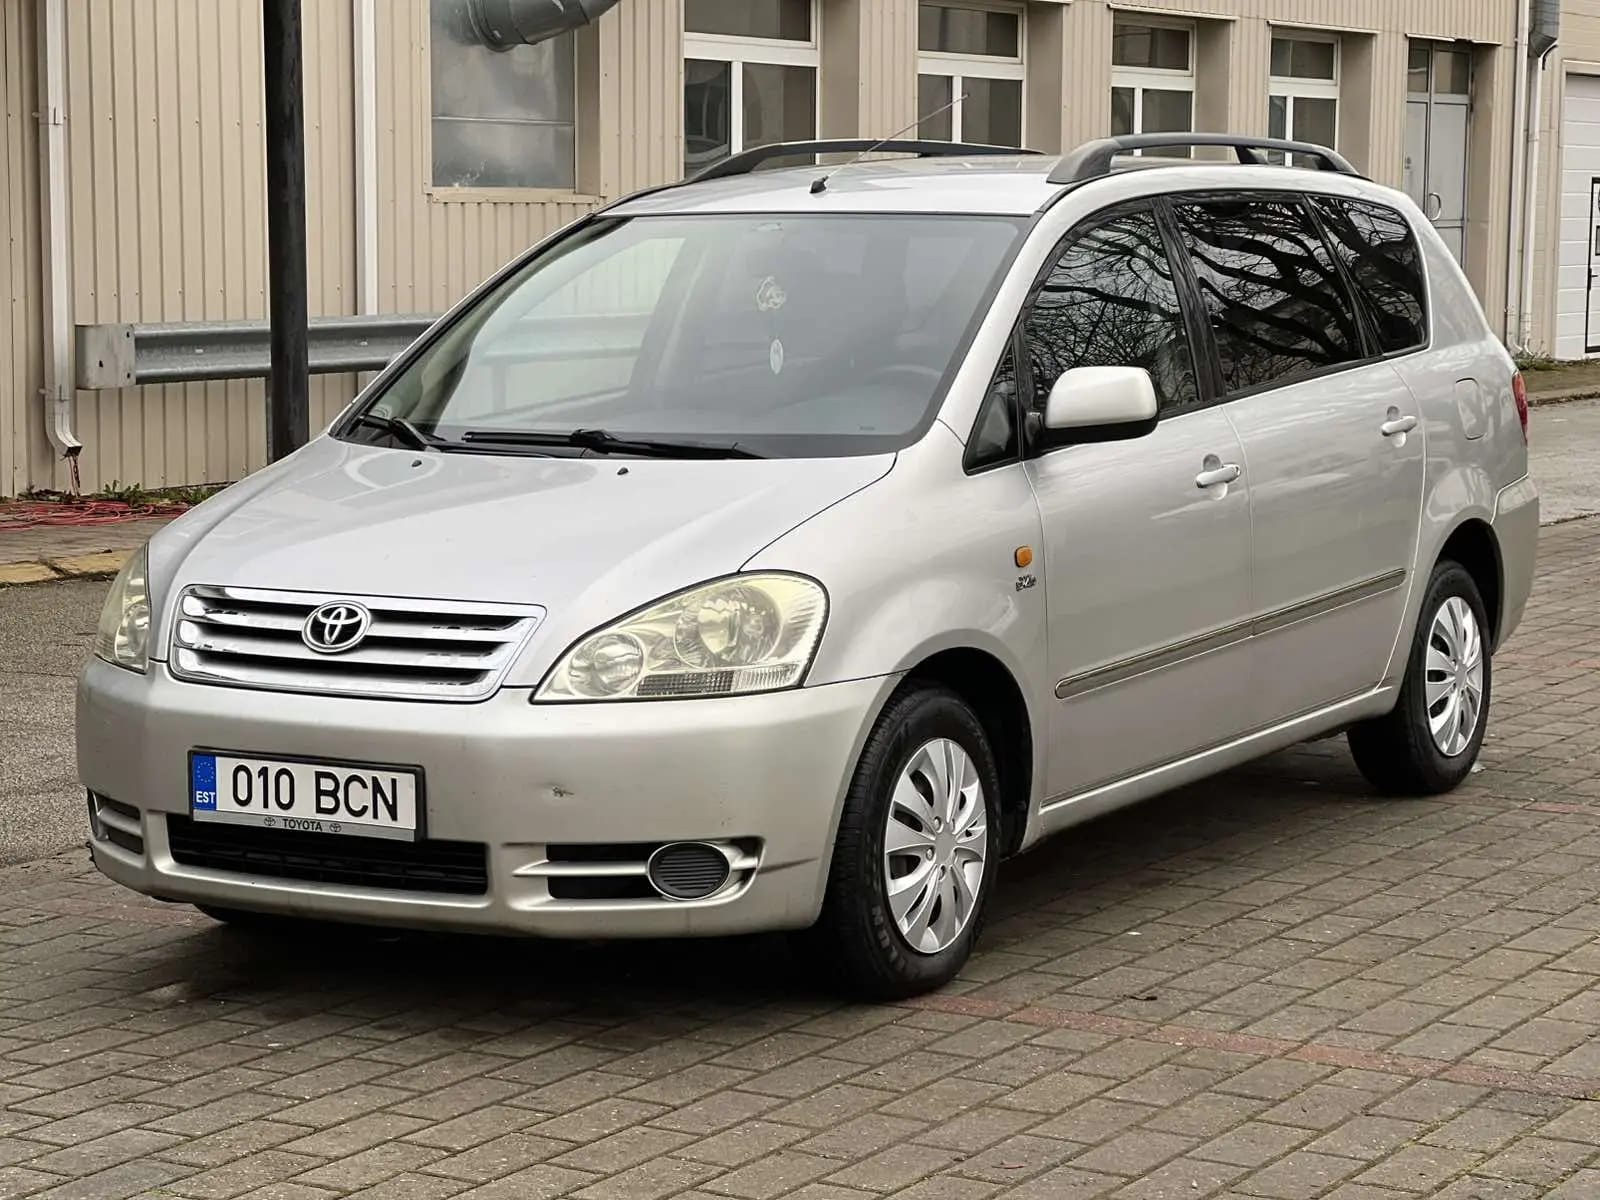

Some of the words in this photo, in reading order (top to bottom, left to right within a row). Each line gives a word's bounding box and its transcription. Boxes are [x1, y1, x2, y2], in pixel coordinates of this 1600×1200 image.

[196, 790, 216, 804] EST
[232, 764, 295, 811] 010
[314, 770, 397, 822] BCN
[282, 818, 323, 832] TOYOTA
